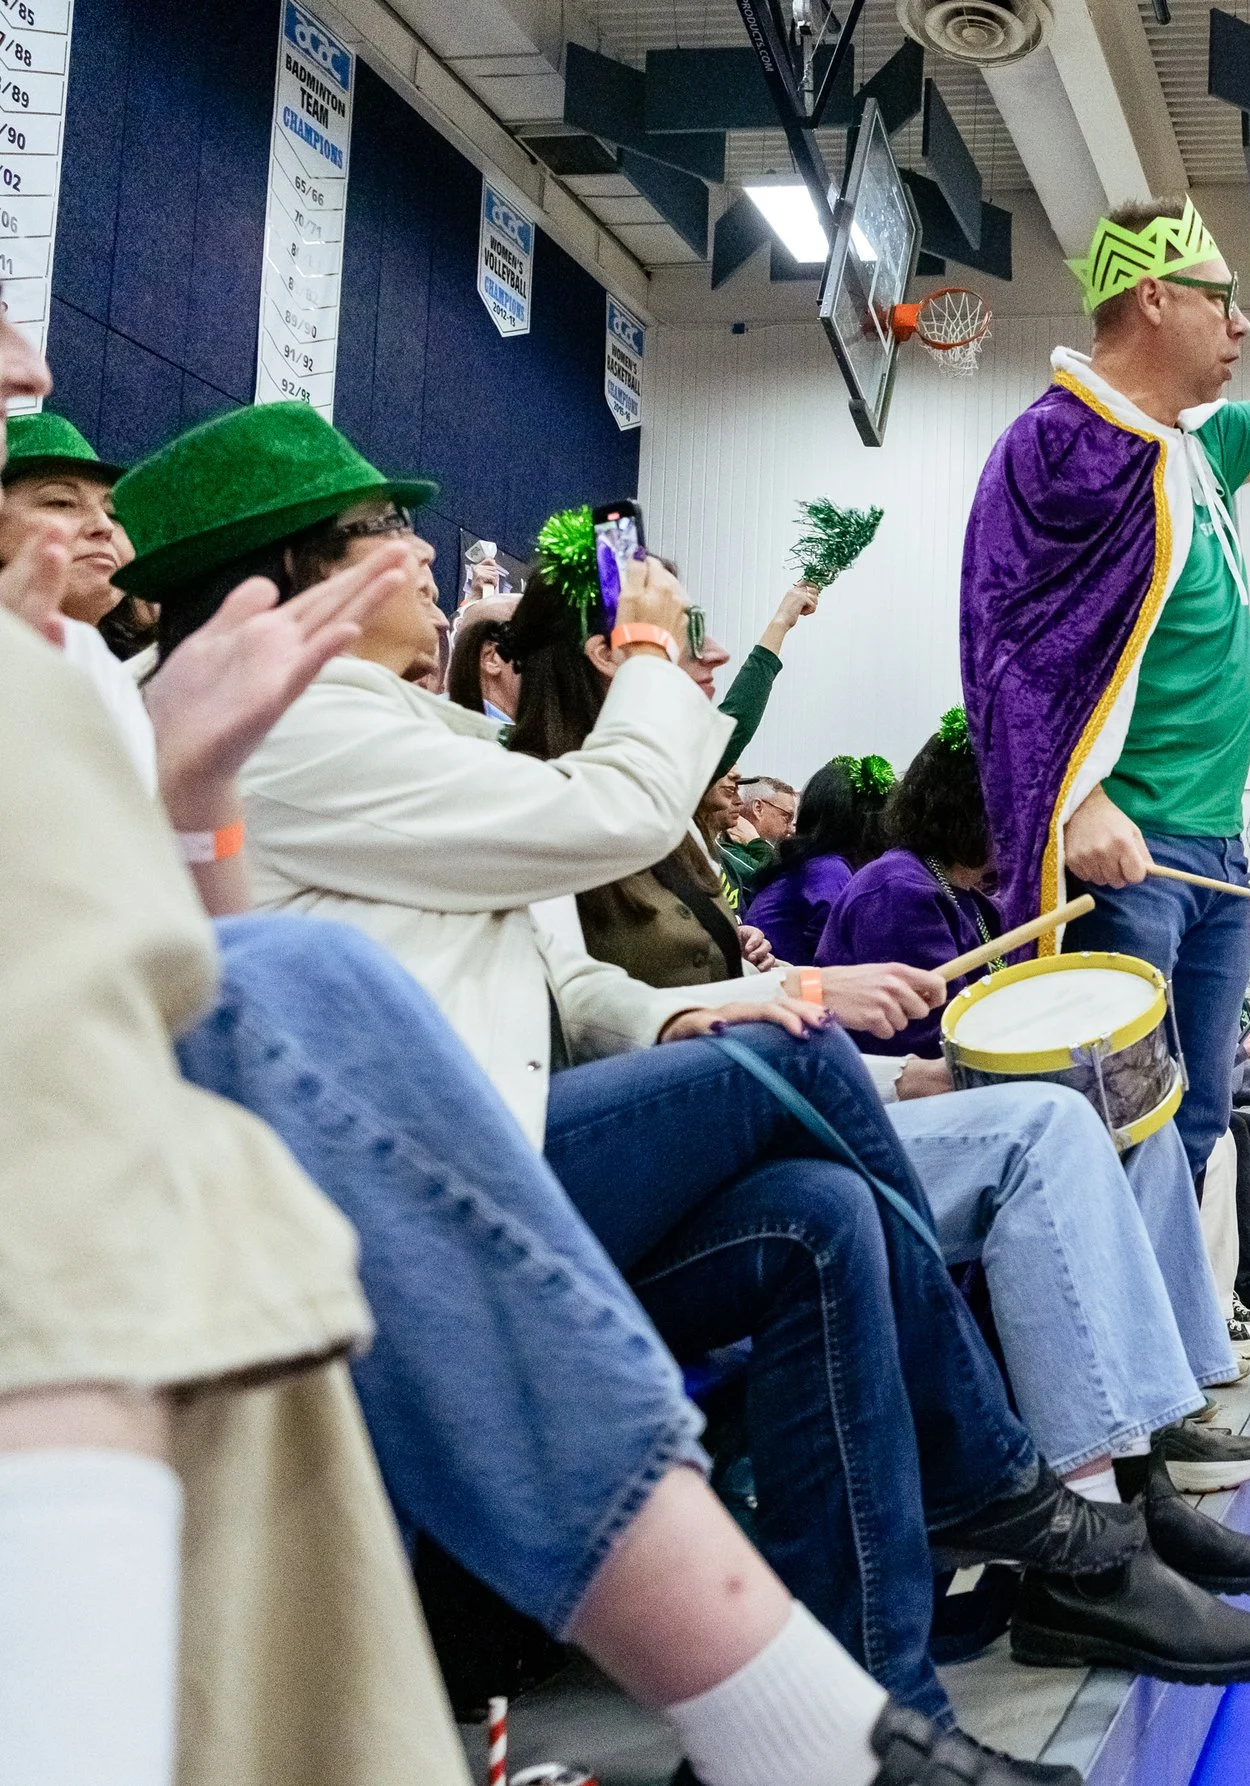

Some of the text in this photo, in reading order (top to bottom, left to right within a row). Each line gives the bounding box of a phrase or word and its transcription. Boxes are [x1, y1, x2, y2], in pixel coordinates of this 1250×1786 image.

[0, 0, 34, 26] /85
[0, 77, 30, 109] /89
[285, 53, 346, 118] BADMINTON
[300, 87, 329, 130] TEAM
[283, 106, 343, 170] CHAMPIONS
[295, 176, 324, 206] 65/66
[484, 248, 527, 299] VOLLEYBALL
[490, 235, 523, 275] WOMEN'S
[484, 276, 525, 323] CHAMPIONS
[284, 345, 314, 372] 91/92
[607, 354, 641, 397] BASKETBALL
[611, 343, 637, 375] WOMEN'S
[281, 379, 311, 405] 92/93
